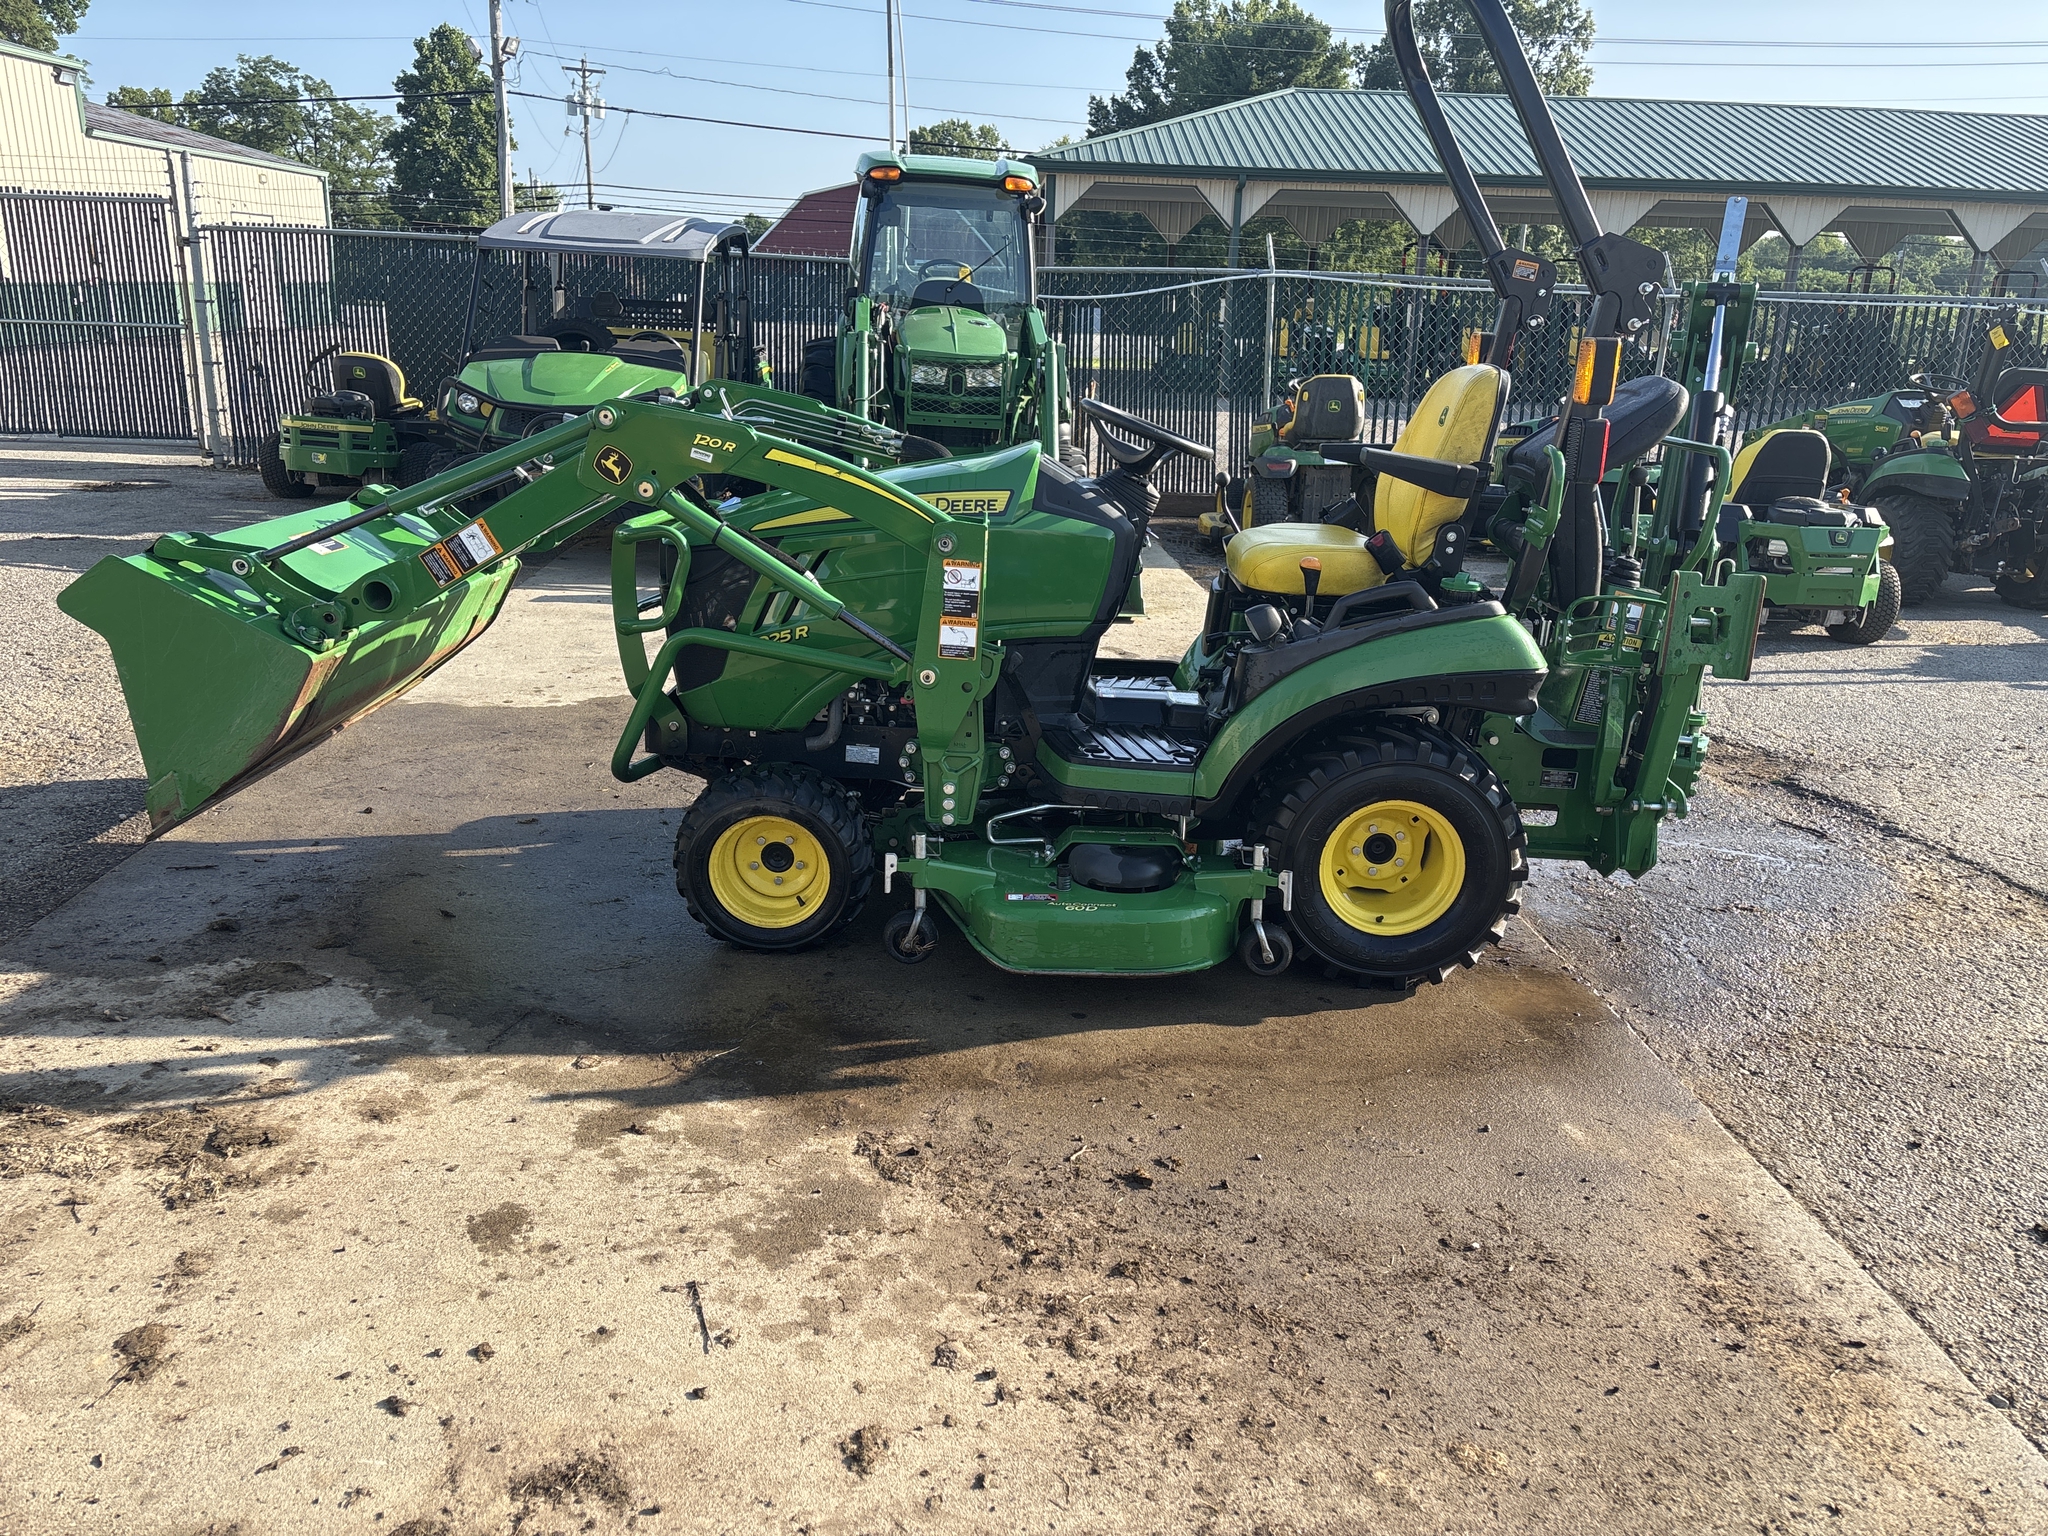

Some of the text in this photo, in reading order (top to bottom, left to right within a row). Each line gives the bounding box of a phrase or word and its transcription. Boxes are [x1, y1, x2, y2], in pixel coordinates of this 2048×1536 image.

[693, 433, 737, 452] 120 R
[935, 497, 999, 512] DEERE
[949, 560, 981, 568] WARNING
[947, 619, 977, 627] WARNING
[759, 625, 809, 643] 25 R
